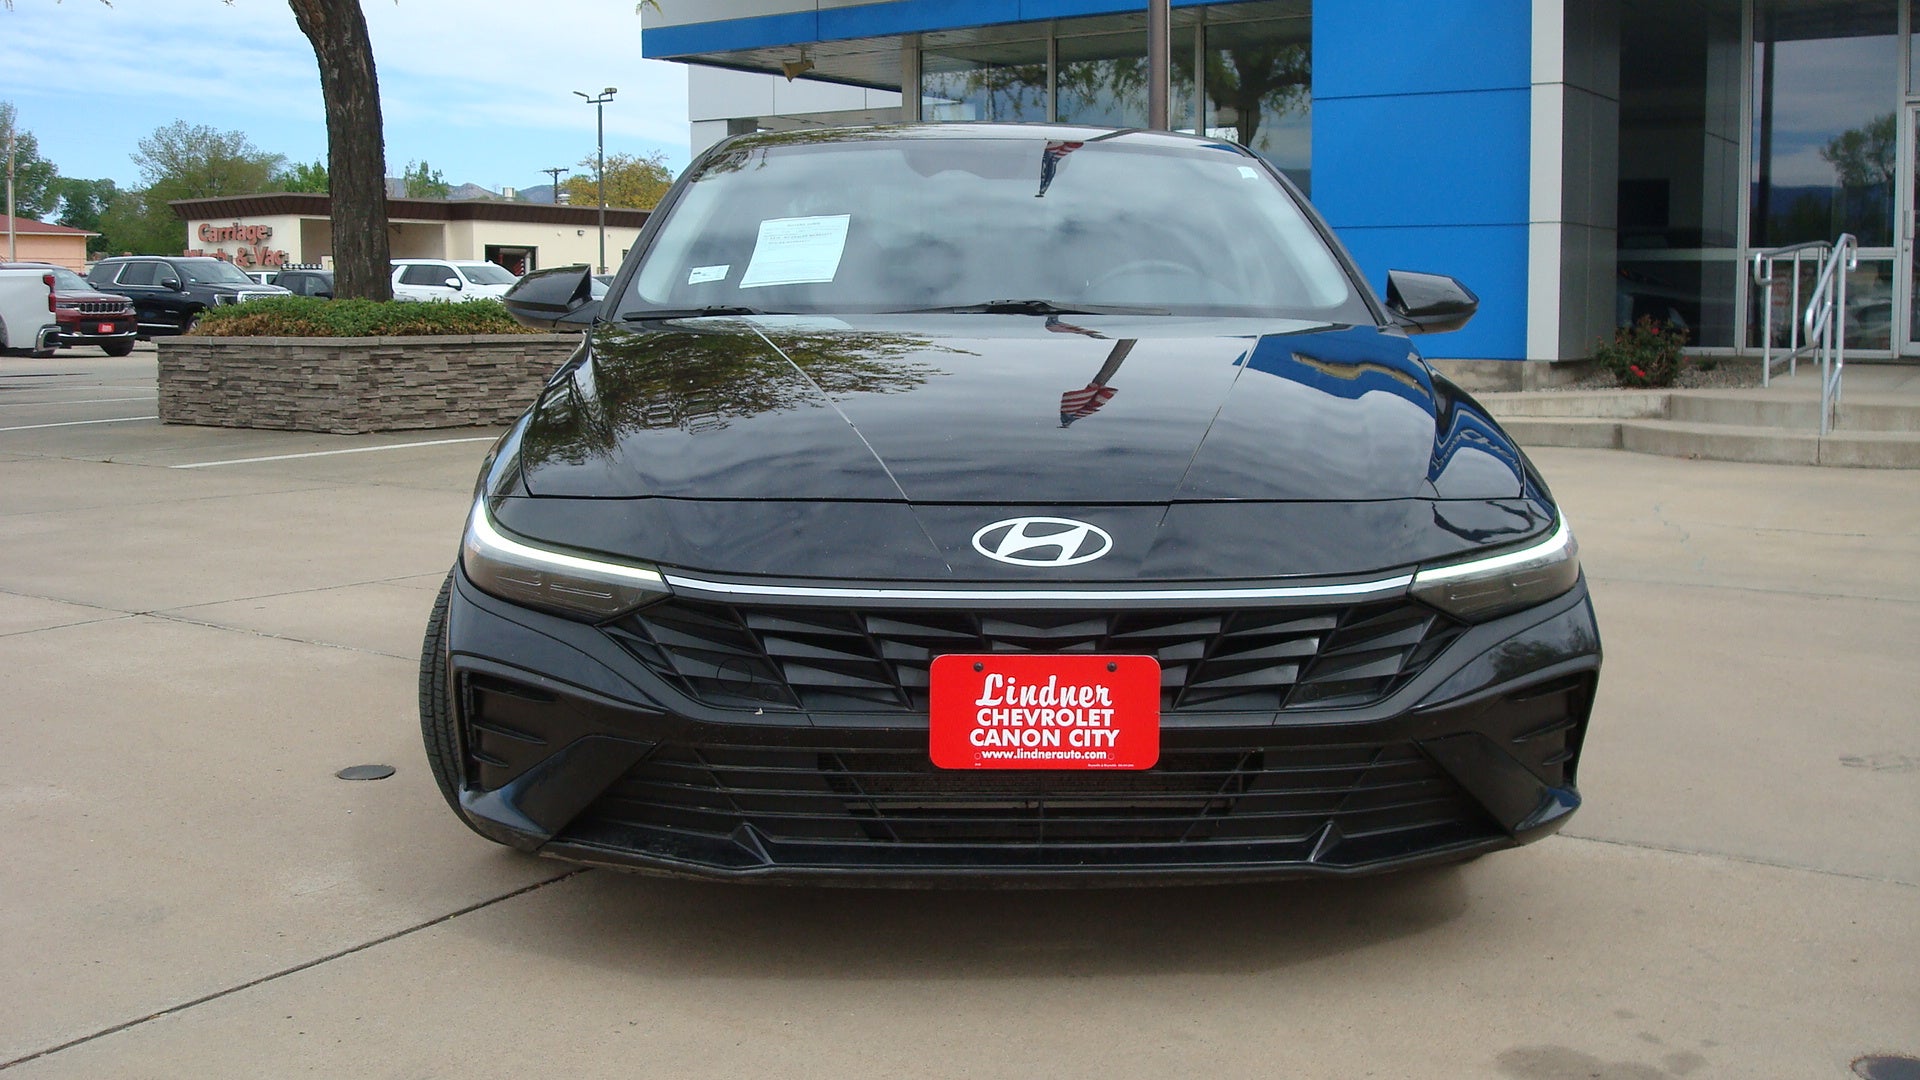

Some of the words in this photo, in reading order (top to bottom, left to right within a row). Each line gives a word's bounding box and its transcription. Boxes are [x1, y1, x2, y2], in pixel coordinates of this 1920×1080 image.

[198, 223, 269, 246] Carriage
[236, 247, 250, 267] &
[253, 246, 284, 266] Vac
[975, 673, 1113, 707] Lindner
[976, 708, 1114, 727] CHEVROLET
[969, 728, 1061, 747] CANON
[1068, 728, 1120, 747] CITY
[981, 748, 1107, 760] www.lindnerauto.com
